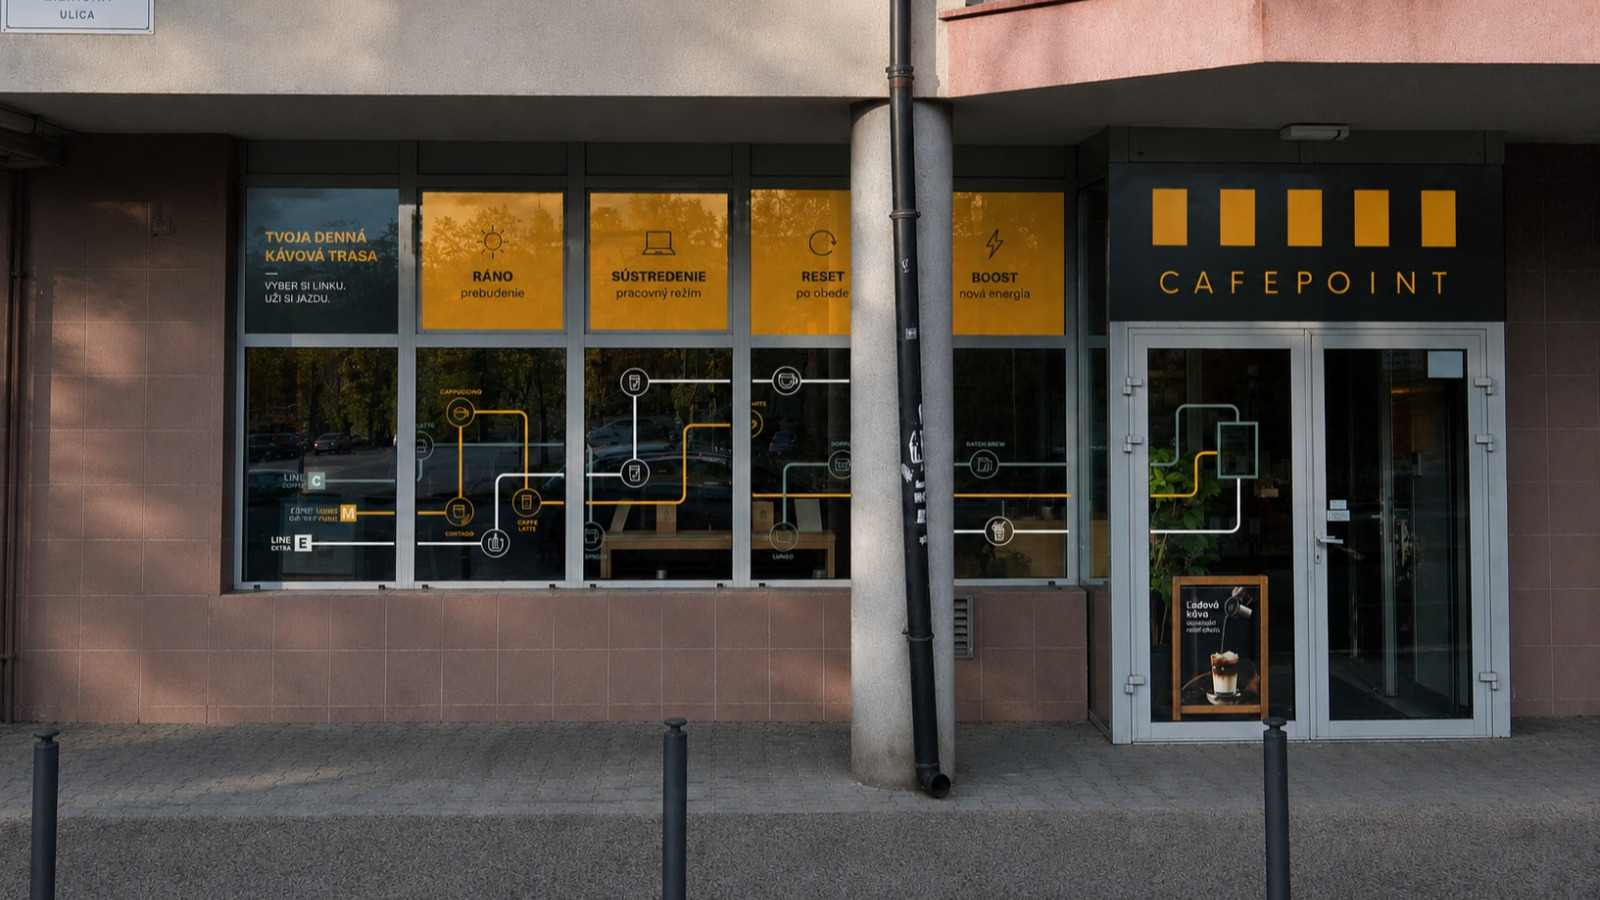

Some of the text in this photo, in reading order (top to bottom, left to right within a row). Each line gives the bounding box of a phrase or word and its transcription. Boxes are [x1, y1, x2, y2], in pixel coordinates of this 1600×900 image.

[60, 10, 95, 19] ULICA
[265, 228, 367, 243] TVOJA DENNÁ
[265, 247, 378, 262] KÁVOVÁ TRASA
[473, 268, 513, 282] RÁNO
[612, 268, 706, 282] SÚSTREDENIE
[802, 271, 844, 282] RESET
[972, 272, 1018, 283] BOOST
[301, 281, 310, 290] SI
[313, 281, 346, 290] LINKU.
[1159, 270, 1447, 295] CAFEPOINT
[265, 292, 330, 303] UŽI SI JAZDU.
[461, 288, 525, 300] prebudenie
[616, 287, 701, 300] pracovný režim
[796, 288, 849, 300] po obede
[959, 288, 1030, 300] nová energia
[312, 475, 321, 487] C
[342, 507, 355, 519] M
[270, 536, 291, 544] LINE
[299, 537, 307, 548] E
